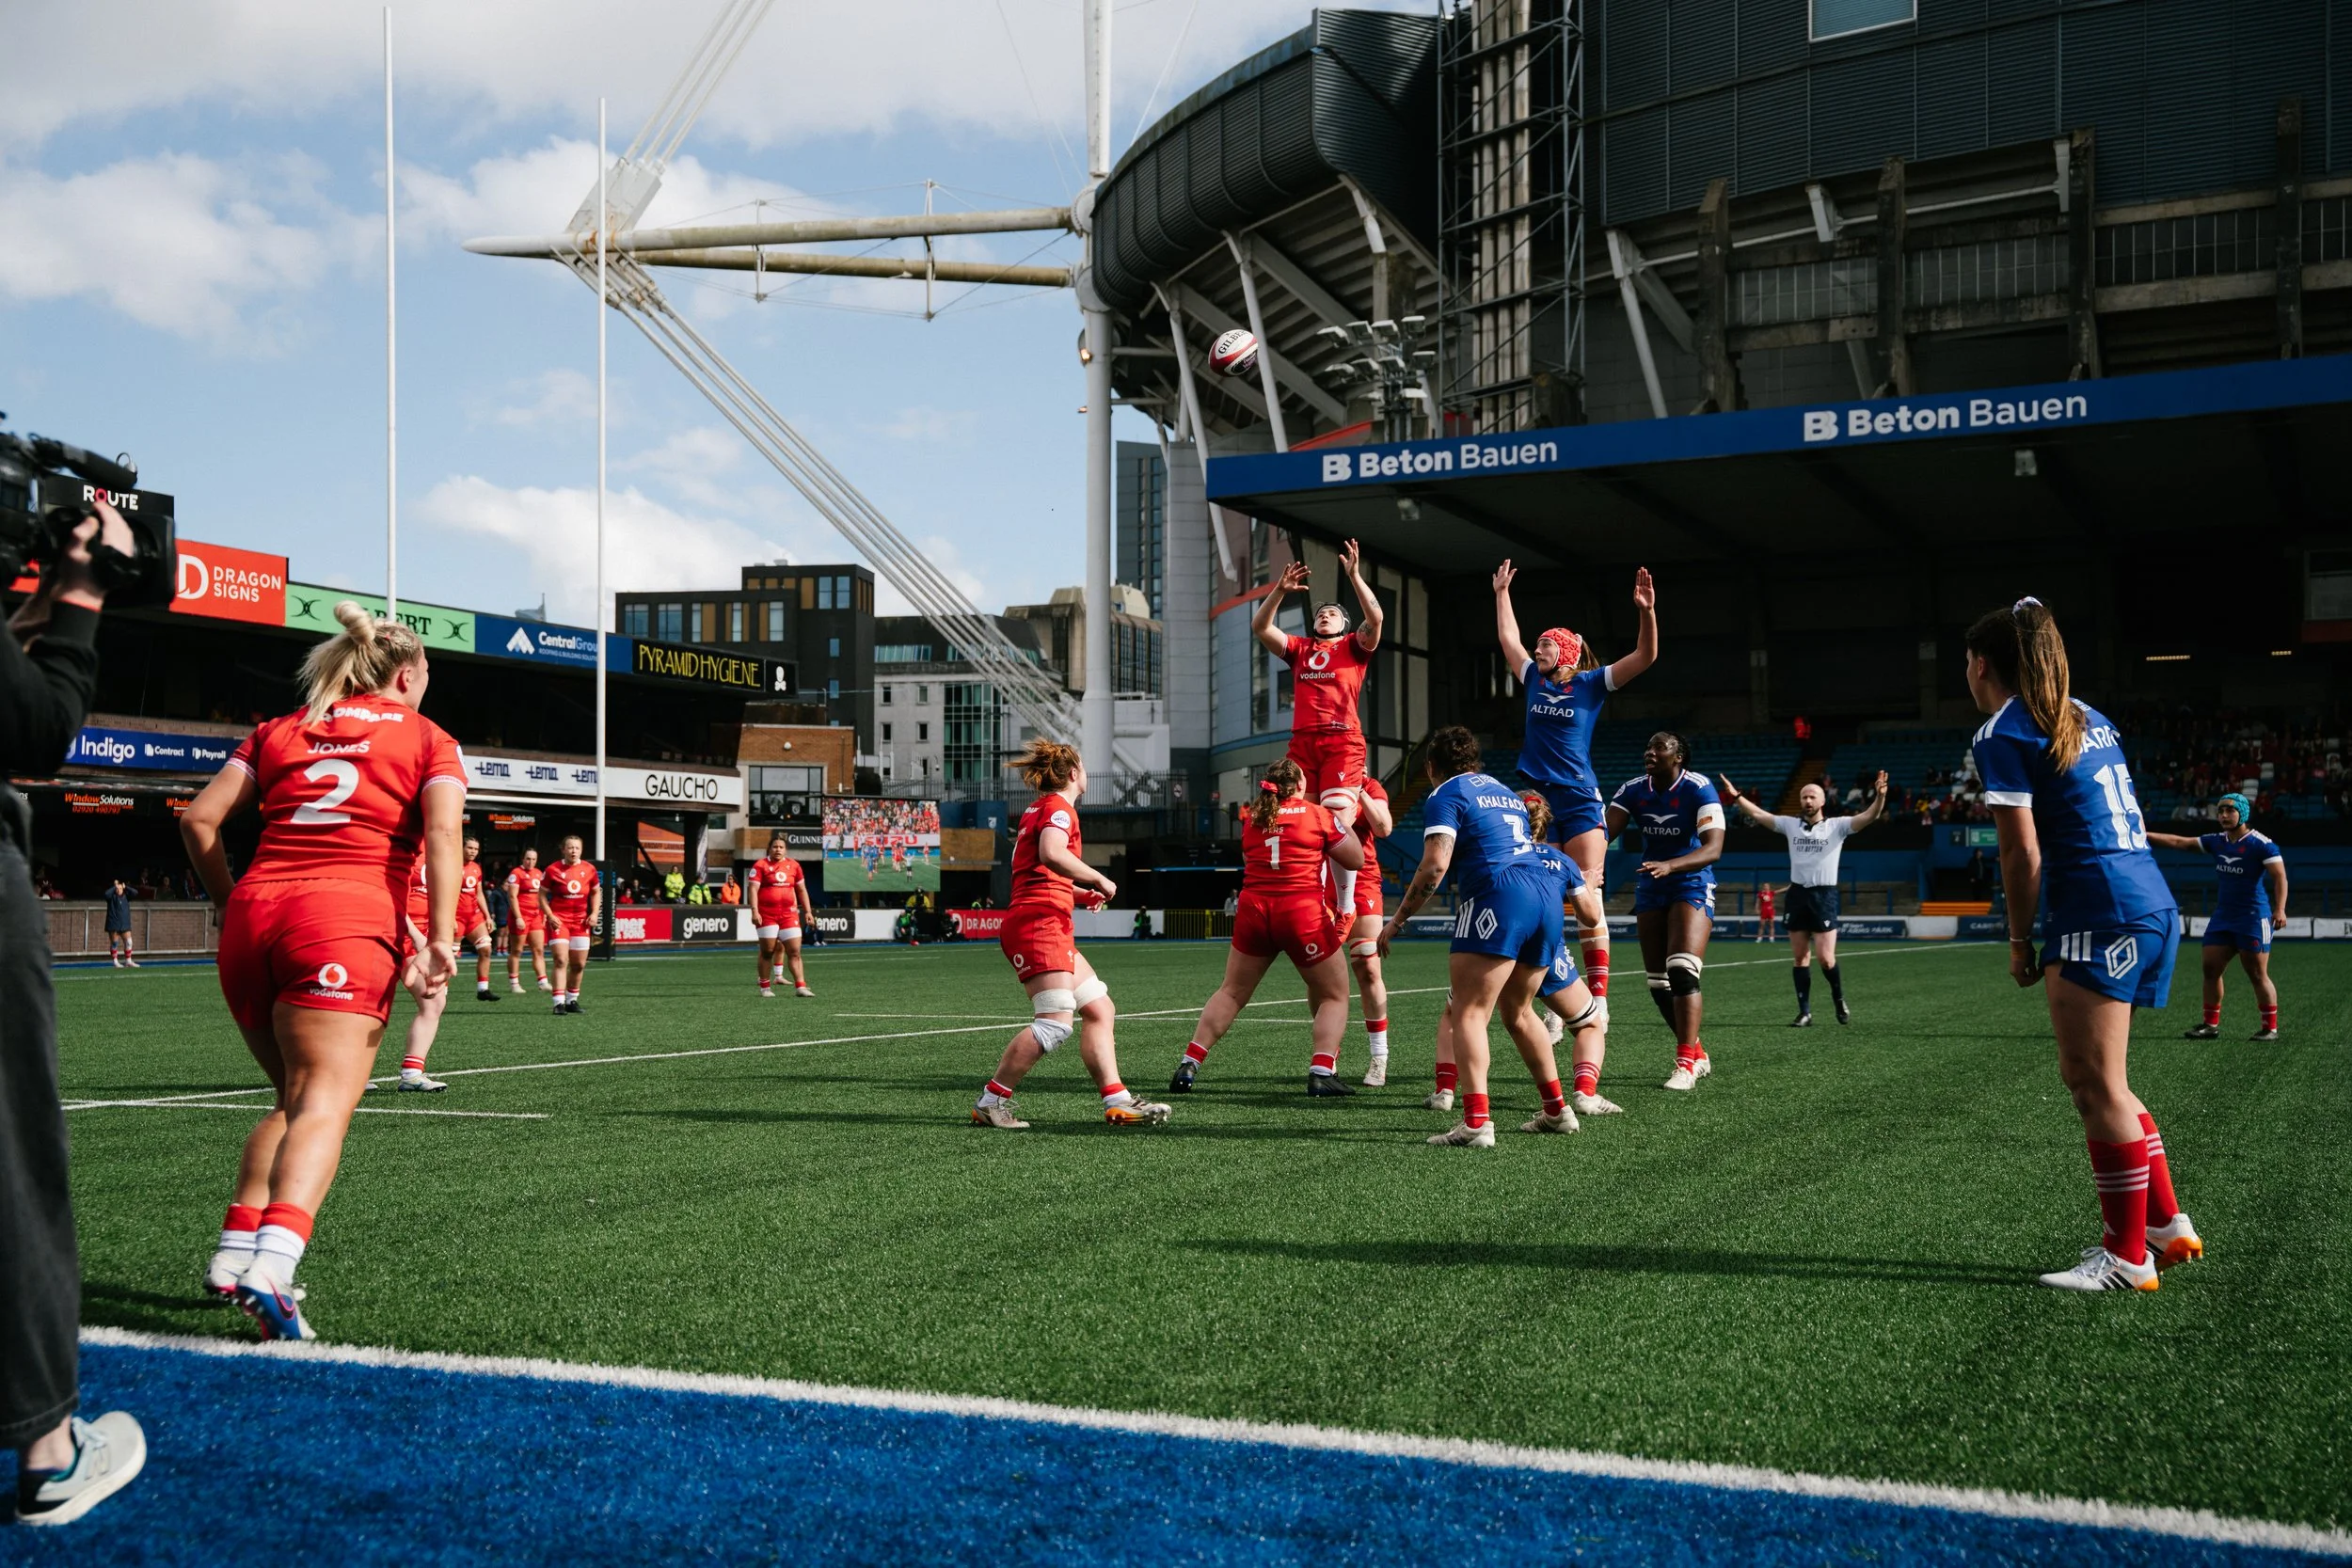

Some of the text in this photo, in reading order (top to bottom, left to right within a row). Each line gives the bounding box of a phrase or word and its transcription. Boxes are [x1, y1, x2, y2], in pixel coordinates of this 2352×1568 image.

[1848, 404, 1960, 436] Beton
[1969, 394, 2088, 427] Bauen
[1359, 449, 1453, 478] Beton
[1460, 441, 1557, 470] Bauen
[83, 485, 138, 511] ROUTE
[214, 566, 281, 590] DRAGON
[214, 582, 260, 603] SIGNS
[538, 631, 598, 653] CentralGrou
[1530, 704, 1575, 718] ALTRAD
[81, 735, 227, 764] Indigo Contract Payroll
[307, 740, 371, 754] JONES
[290, 758, 359, 825] 2
[645, 773, 719, 800] GAUCHO
[1476, 795, 1528, 814] KHALFAOU
[2093, 763, 2152, 851] 15
[788, 834, 823, 844] GUINNE
[1643, 826, 1681, 836] ALTRAD
[1792, 837, 1829, 846] Emirates
[1264, 835, 1280, 870] 1
[2216, 864, 2244, 874] ALTRAD
[683, 917, 729, 939] genero
[815, 917, 849, 932] enero
[309, 988, 354, 1001] vodafone
